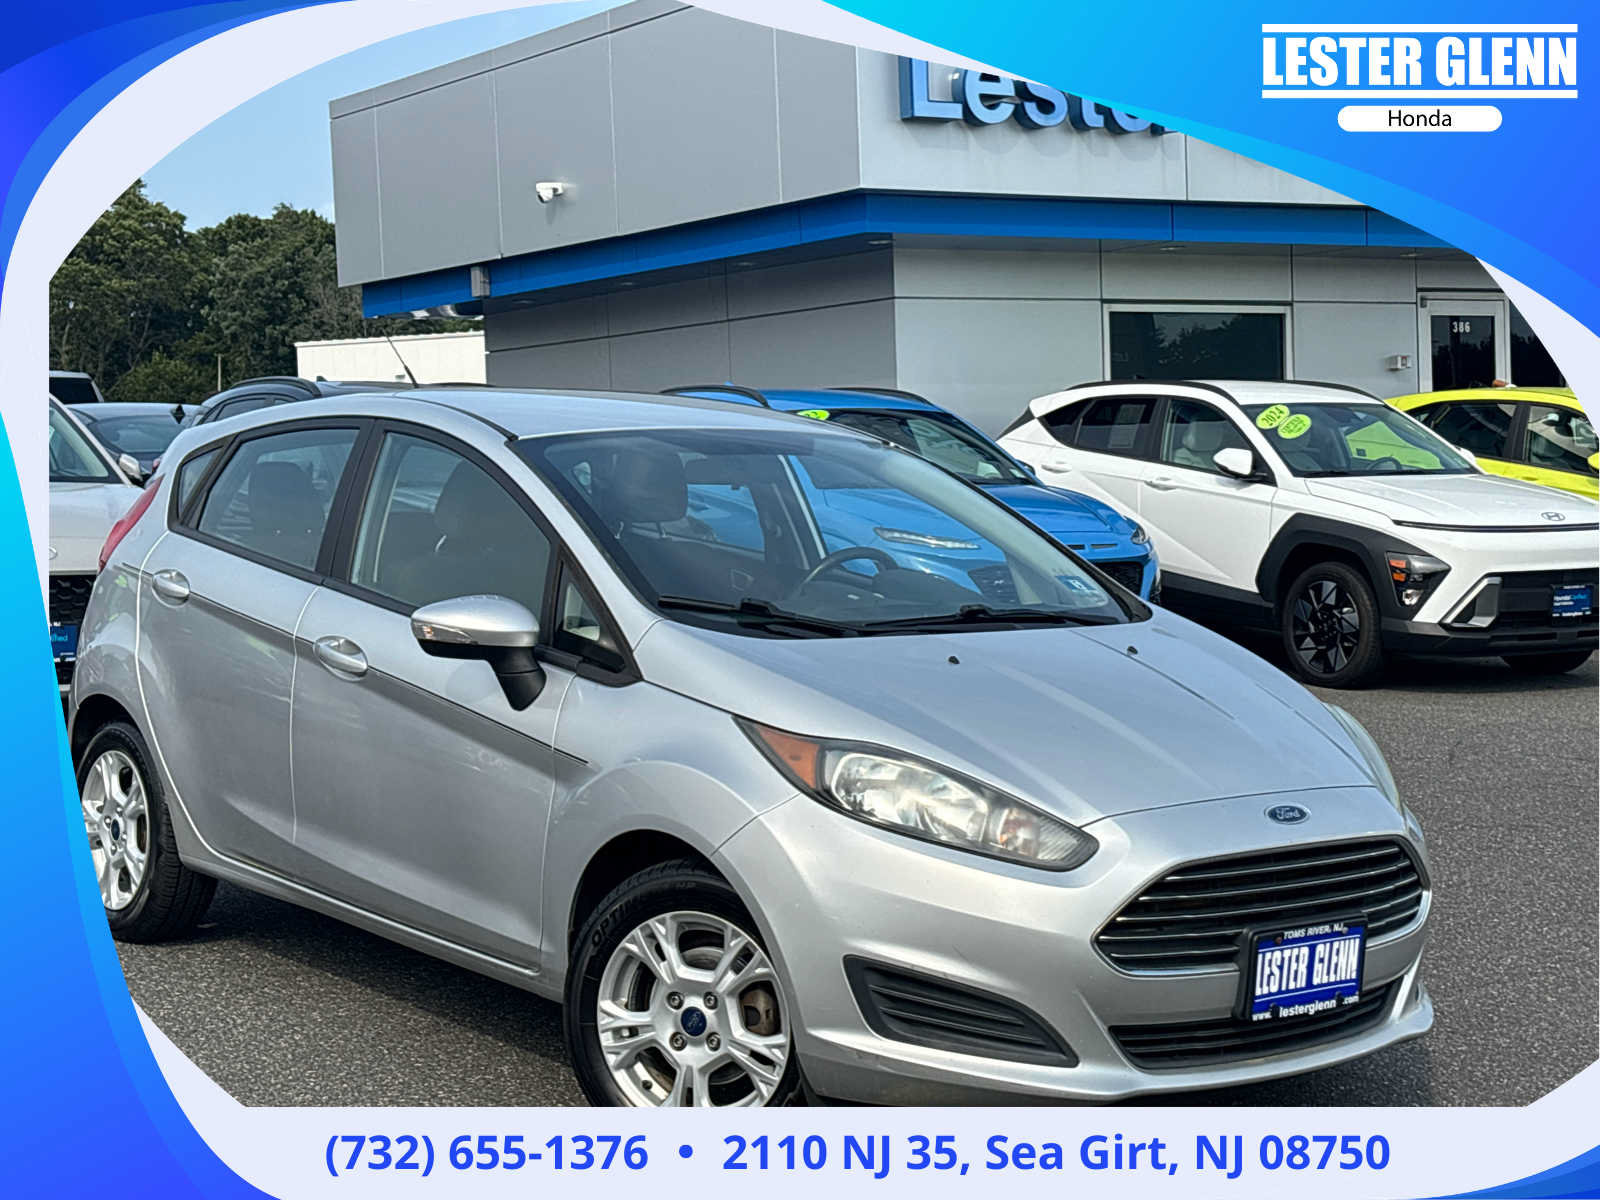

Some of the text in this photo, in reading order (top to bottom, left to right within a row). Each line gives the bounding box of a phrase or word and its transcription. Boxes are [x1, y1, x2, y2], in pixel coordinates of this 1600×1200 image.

[1452, 321, 1471, 333] 386
[1261, 406, 1285, 426] 2024
[1255, 938, 1360, 996] LESTER GLENN
[1279, 999, 1337, 1018] lesterglenn
